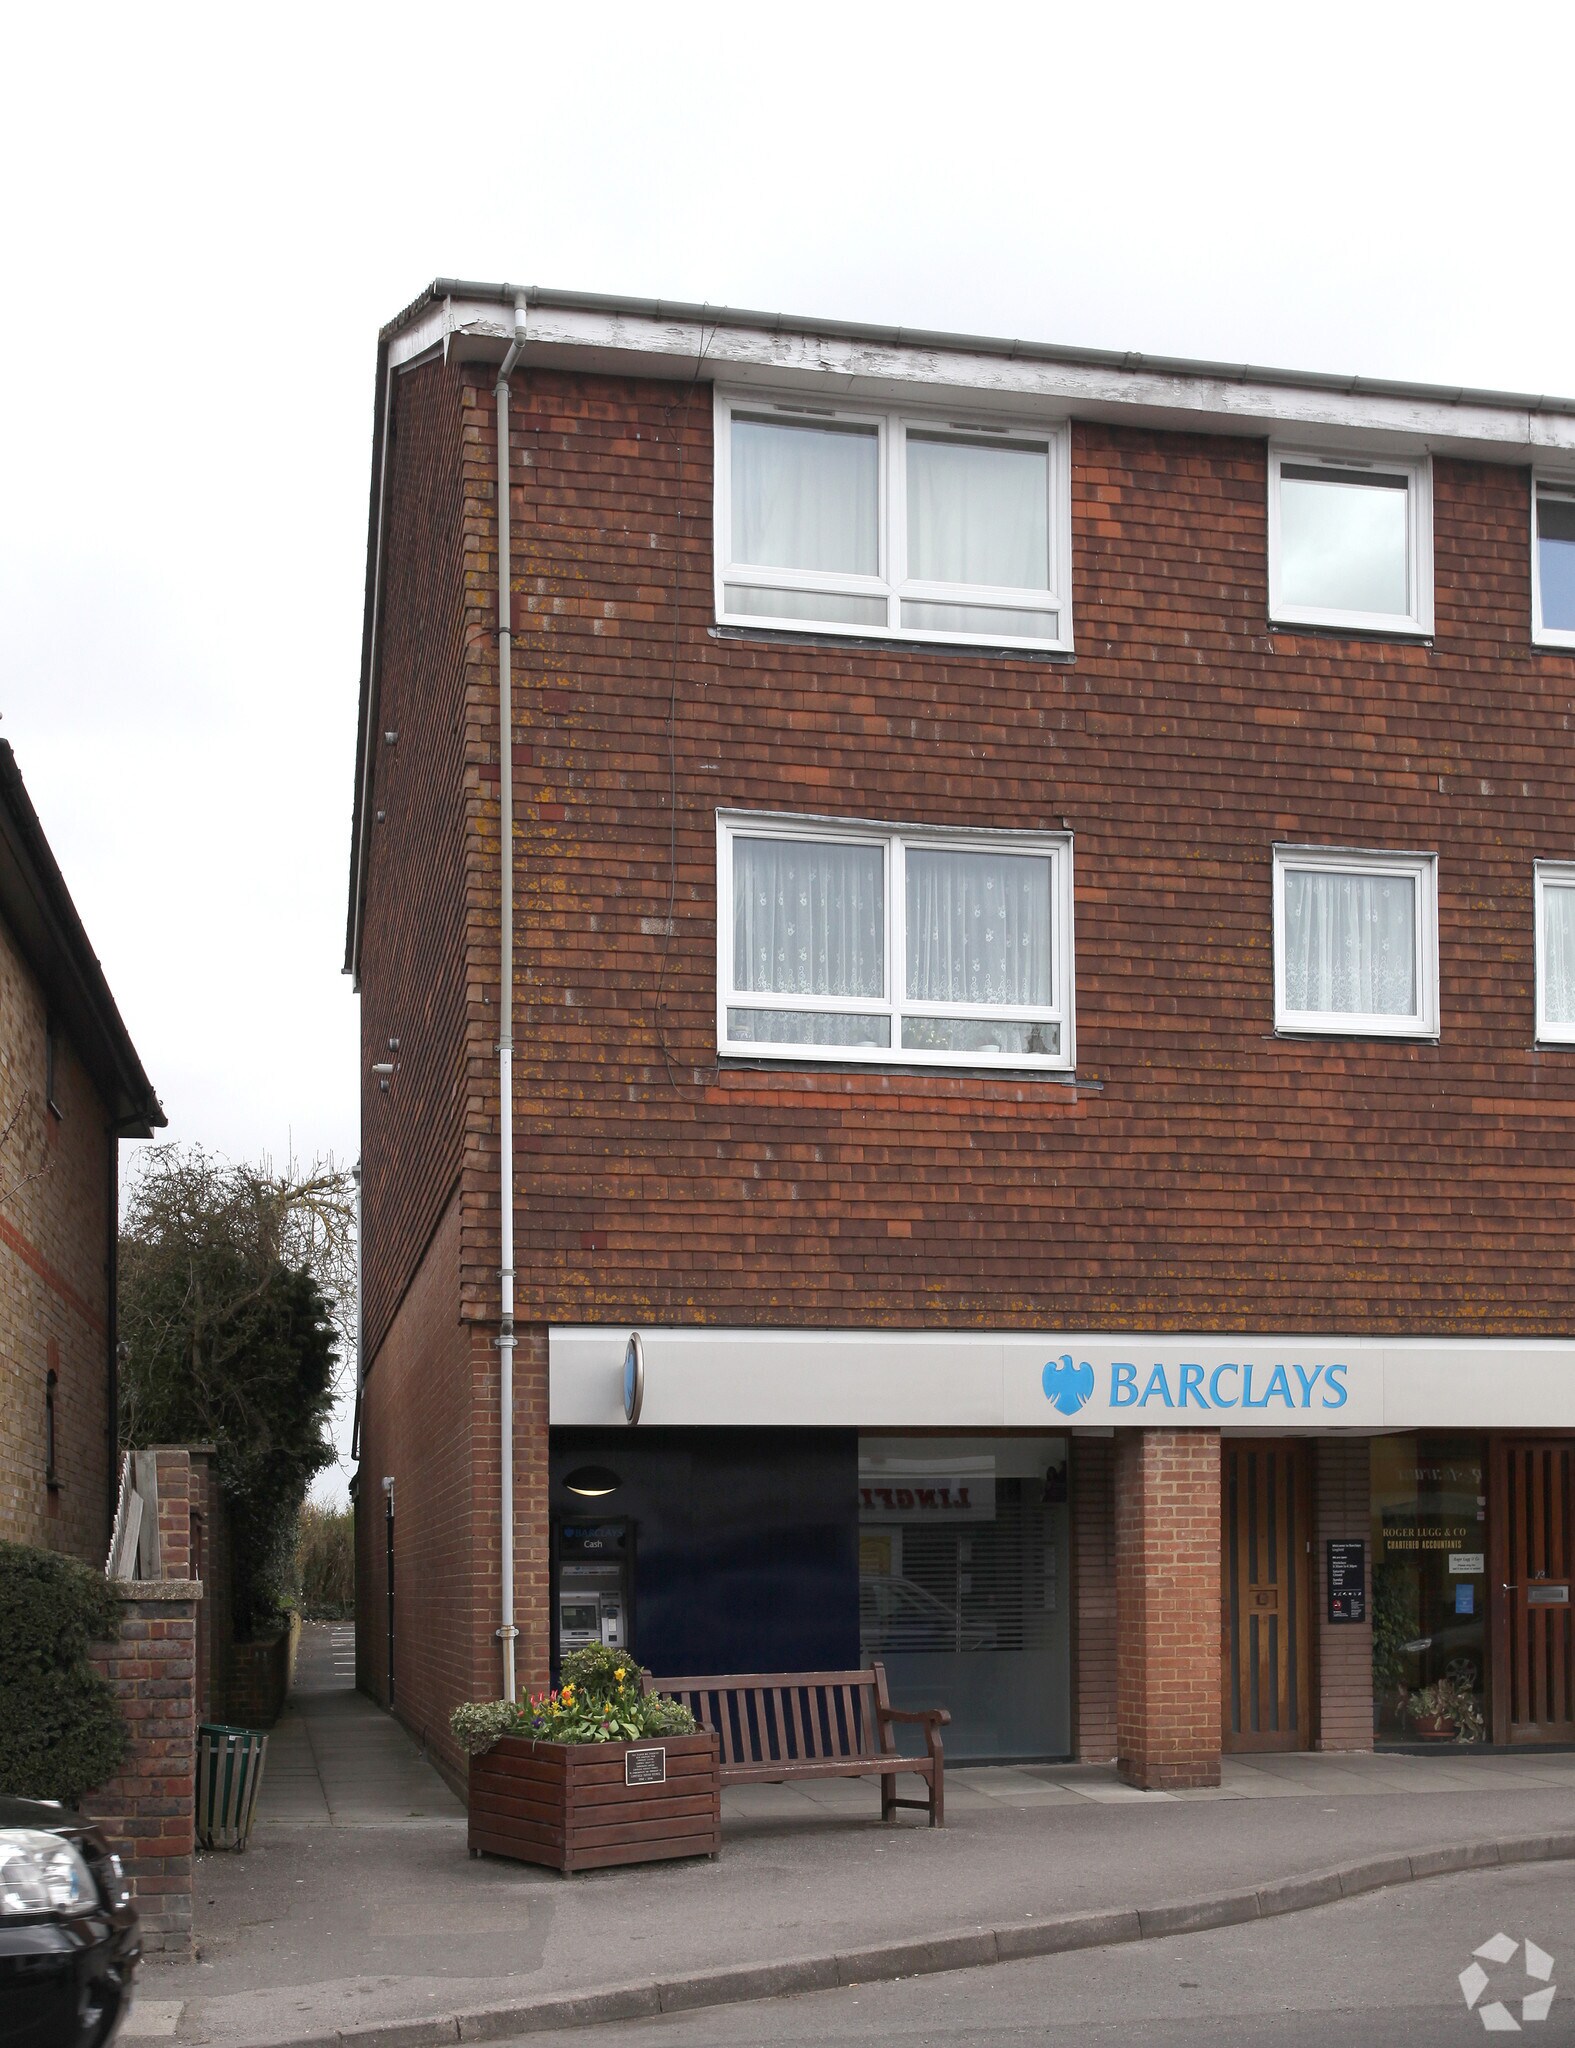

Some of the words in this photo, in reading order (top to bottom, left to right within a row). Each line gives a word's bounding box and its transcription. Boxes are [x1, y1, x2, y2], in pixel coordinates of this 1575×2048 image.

[1108, 1362, 1348, 1409] BARCLAYS
[575, 1528, 625, 1537] BARCLAYS
[1383, 1528, 1415, 1537] ROGER
[1417, 1528, 1442, 1537] LUGG
[1444, 1528, 1451, 1537] &
[1453, 1527, 1467, 1536] CO
[583, 1540, 603, 1548] Cash
[1387, 1540, 1420, 1549] CHARTERED
[1422, 1540, 1462, 1549] ACCOUNTANTS
